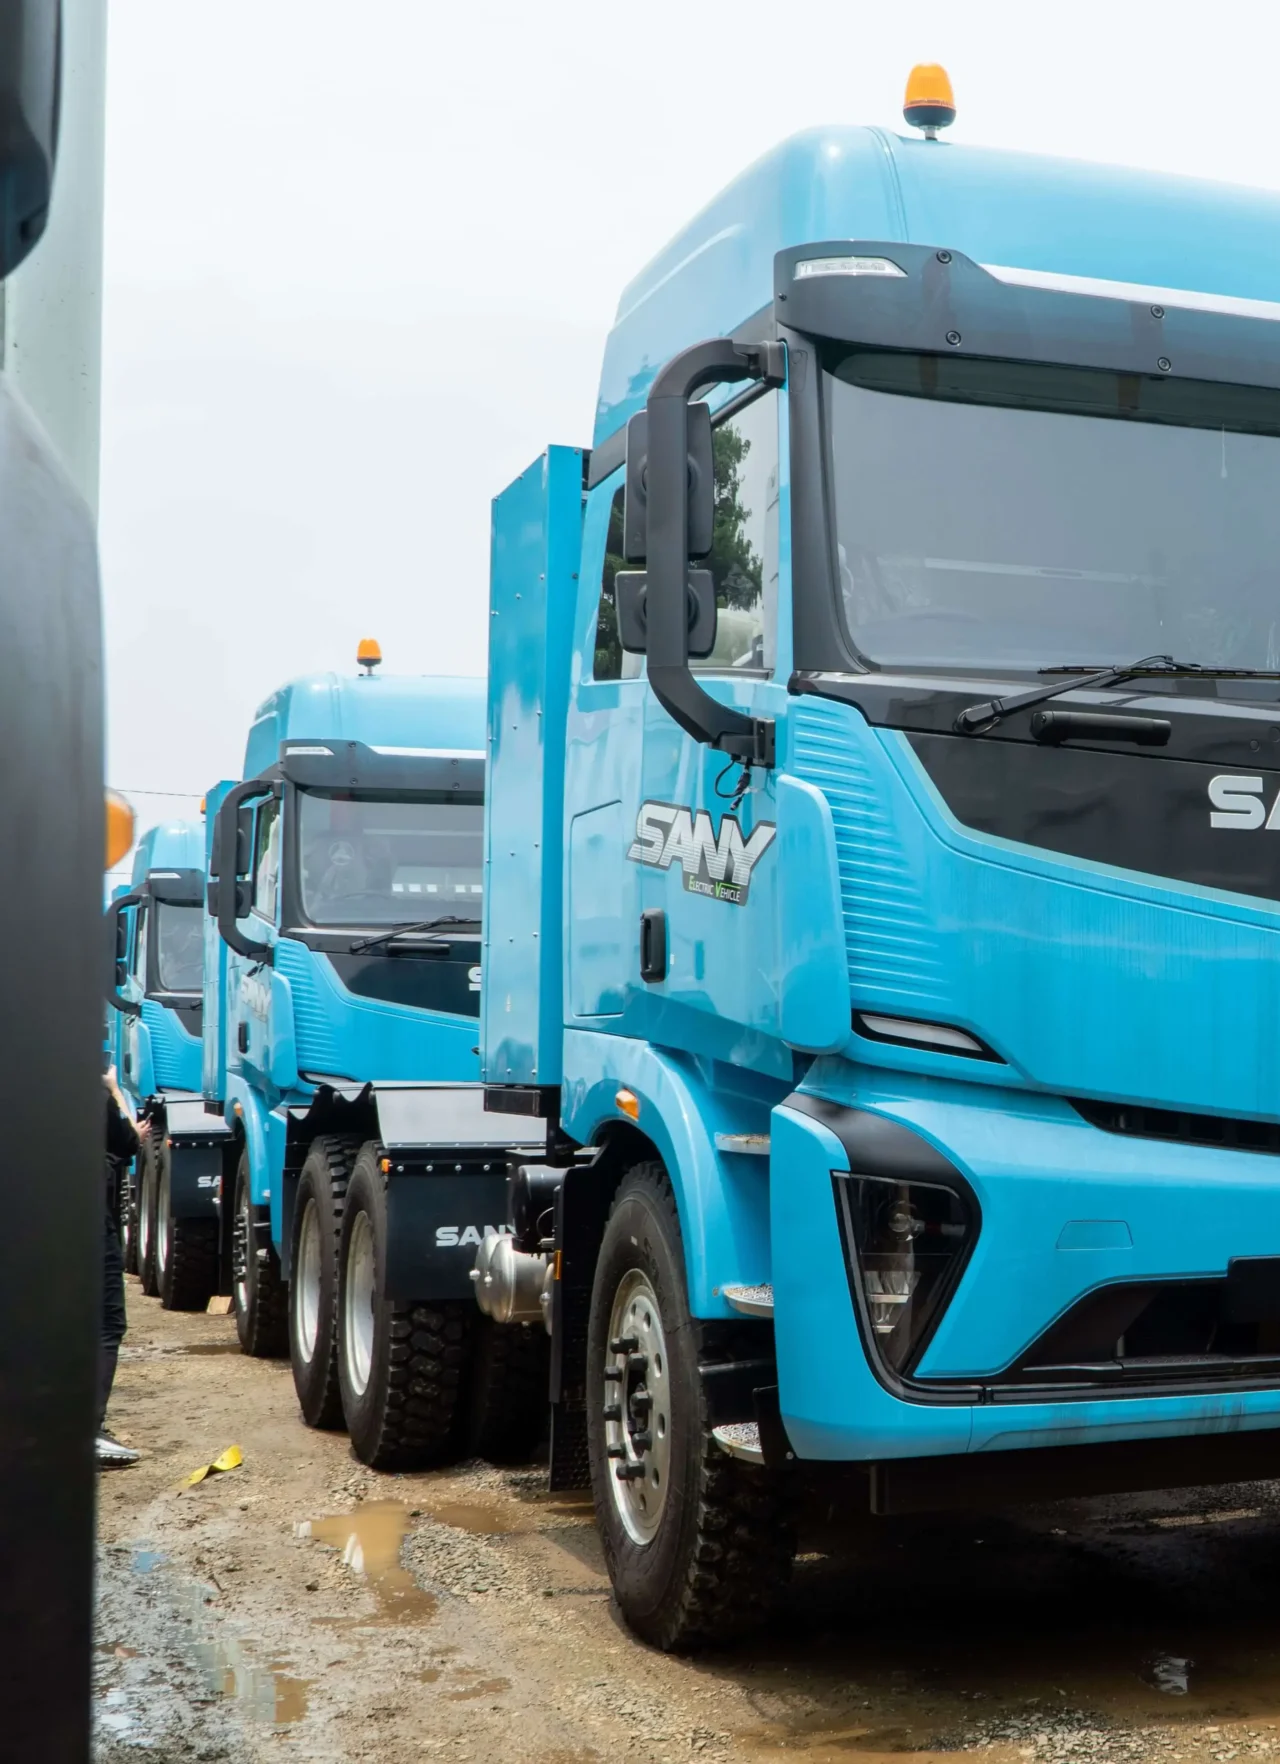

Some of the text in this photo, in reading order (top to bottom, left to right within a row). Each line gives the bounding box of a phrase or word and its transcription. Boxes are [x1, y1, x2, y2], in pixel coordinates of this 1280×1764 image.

[628, 803, 777, 886] SANY
[688, 875, 741, 902] ELECTRIC VEHICLE
[436, 1224, 517, 1247] SA
